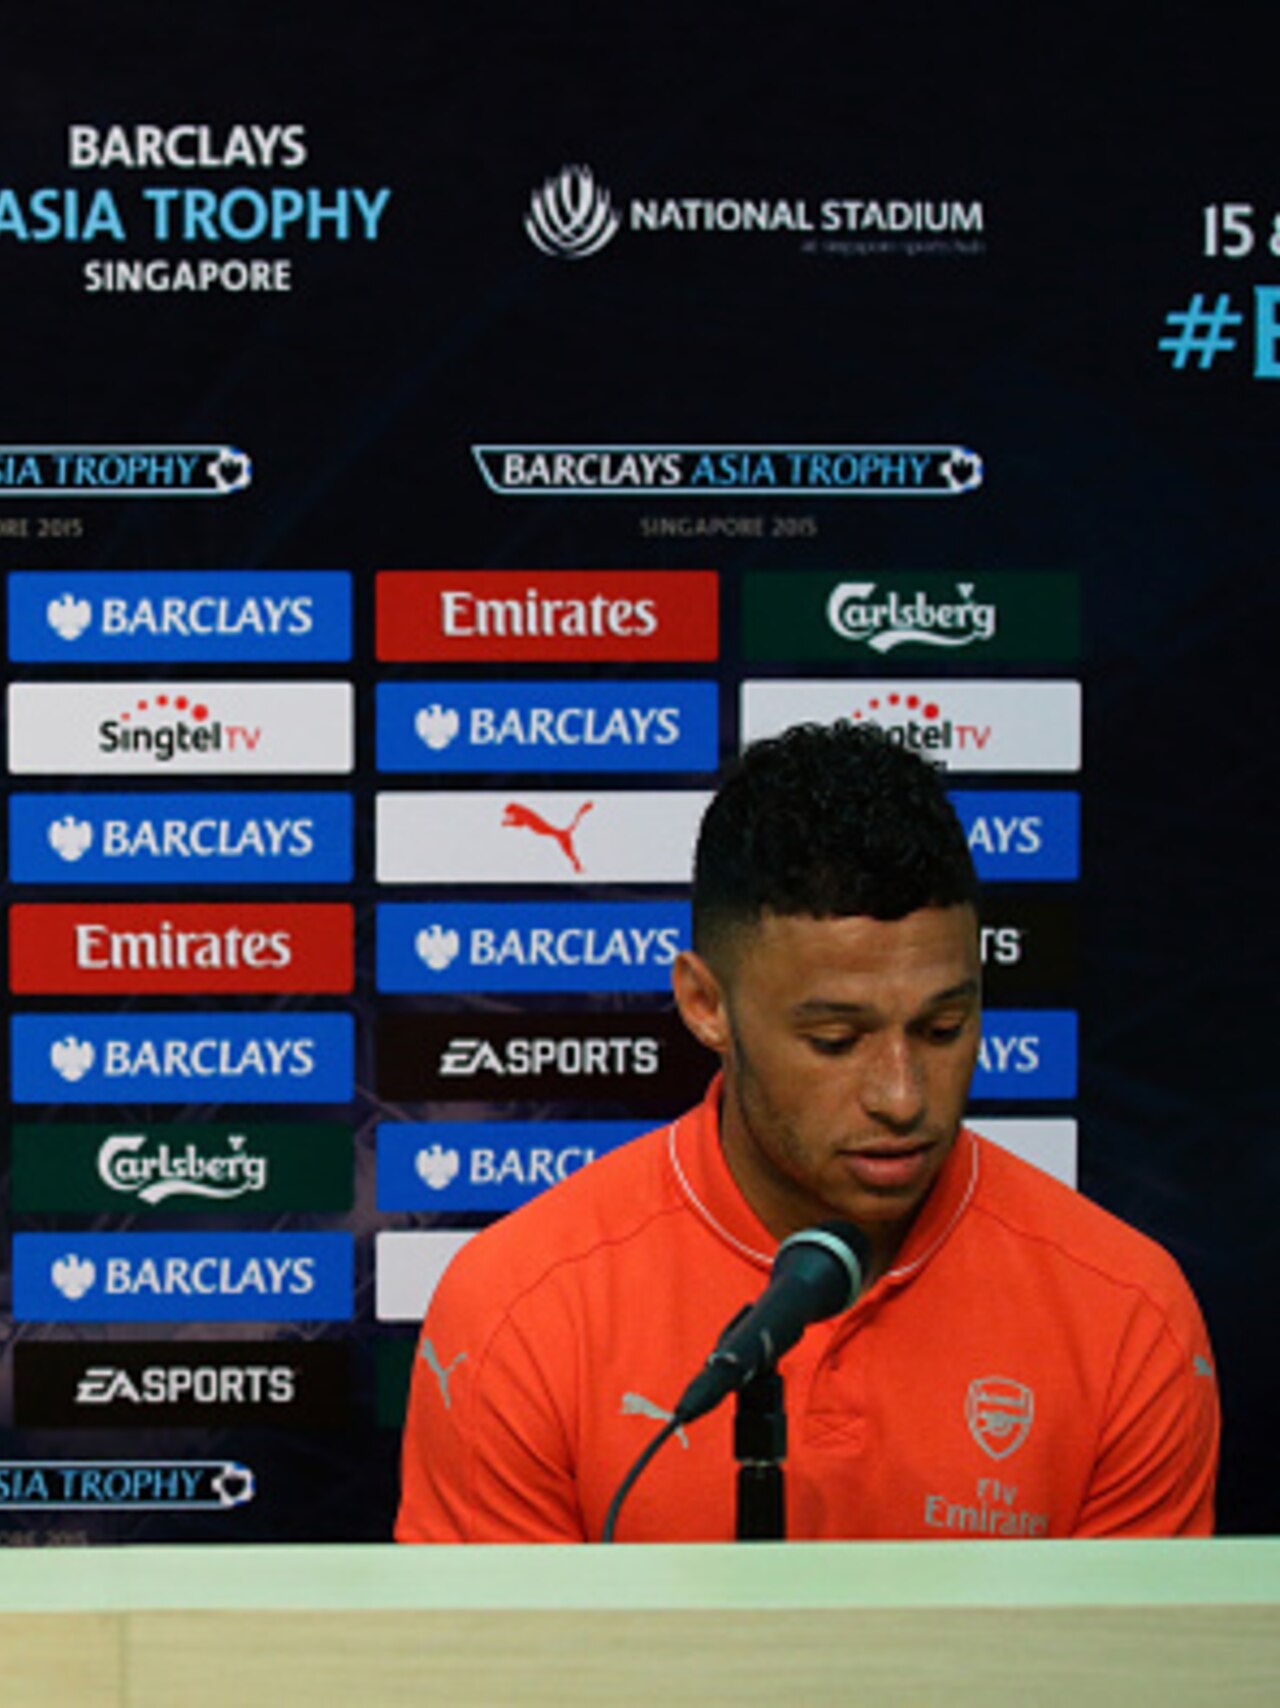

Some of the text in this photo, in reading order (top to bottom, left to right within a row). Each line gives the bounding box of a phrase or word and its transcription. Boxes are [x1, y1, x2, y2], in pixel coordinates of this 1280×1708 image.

[69, 124, 307, 168] BARCLAYS
[143, 187, 391, 240] TROPHY
[631, 199, 984, 231] NATIONAL STADIUM
[1204, 203, 1255, 257] 15
[84, 259, 291, 292] SINGAPORE
[54, 456, 198, 486] TROPHY
[504, 453, 930, 485] BARCLAYS ASIA TROPHY
[640, 516, 764, 537] SINGAPORE
[101, 596, 313, 636] BARCLAYS
[441, 588, 658, 636] Emirates
[827, 582, 997, 644] Carlsberg
[98, 720, 263, 760] Singtel TV
[469, 707, 680, 745] BARCLAYS
[954, 725, 992, 750] TV
[102, 819, 313, 857] BARCLAYS
[76, 921, 291, 969] Emirates
[465, 922, 684, 967] BARCLAYS
[103, 1039, 314, 1077] BARCLAYS
[438, 1038, 659, 1075] EA SPORTS
[97, 1135, 267, 1196] Carlsberg
[105, 1257, 314, 1295] BARCLAYS
[77, 1367, 295, 1404] EA SPORTS
[60, 1468, 203, 1500] TROPHY
